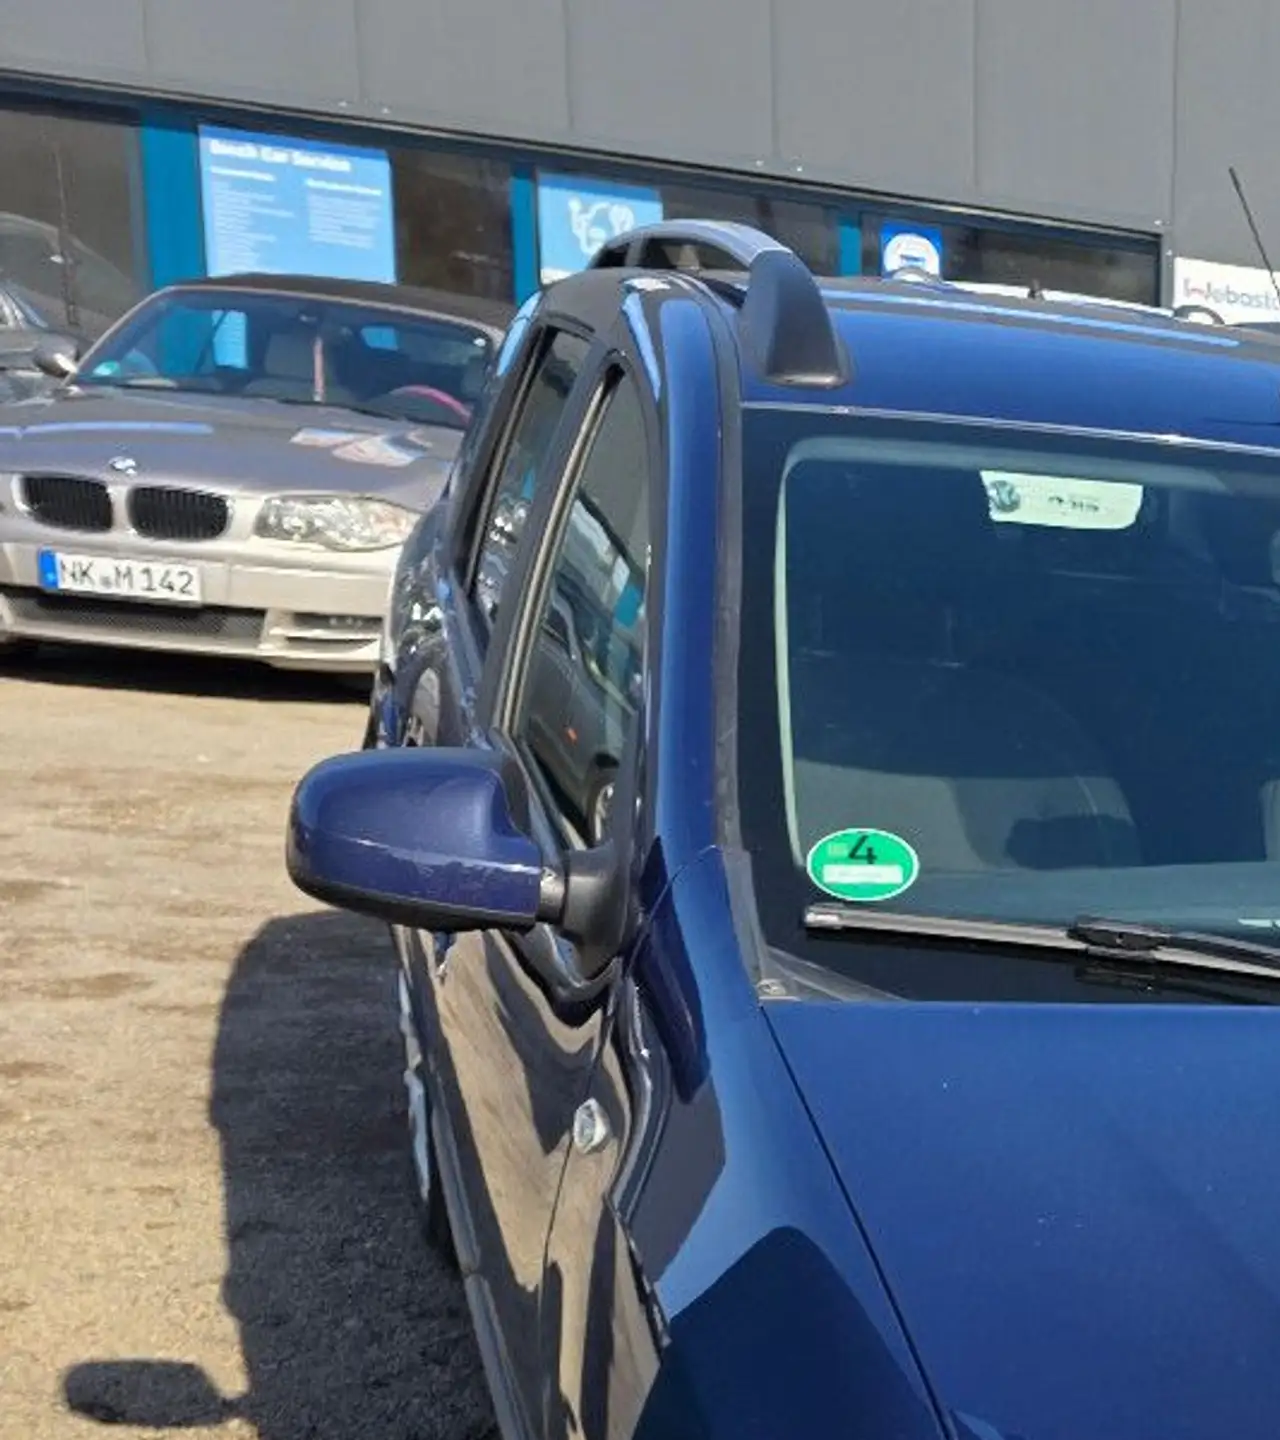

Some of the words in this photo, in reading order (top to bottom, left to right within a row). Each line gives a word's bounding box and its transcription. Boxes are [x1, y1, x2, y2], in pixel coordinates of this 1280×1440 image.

[60, 559, 96, 587] NK
[114, 565, 134, 590] M
[140, 566, 194, 597] 142
[847, 834, 879, 865] 4
